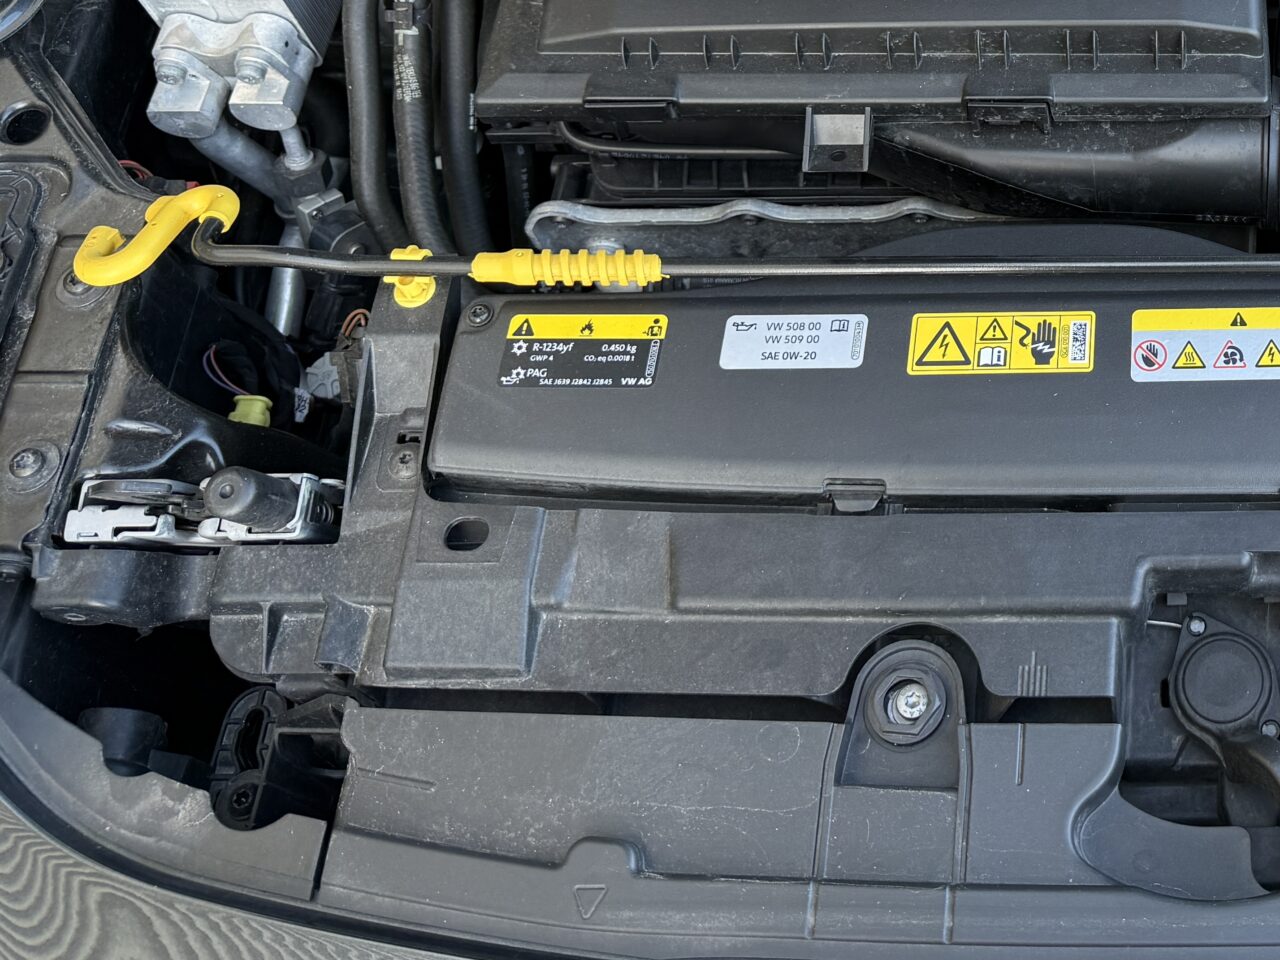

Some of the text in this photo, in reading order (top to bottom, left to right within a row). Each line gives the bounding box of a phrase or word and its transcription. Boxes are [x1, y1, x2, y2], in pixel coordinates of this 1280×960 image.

[766, 322, 822, 331] VW 508 00
[764, 335, 820, 344] VW 509 00
[532, 342, 638, 354] R-1234yf 0.450 kg
[760, 351, 817, 361] SAE 0W-20
[526, 368, 548, 378] PAG
[539, 378, 553, 386] SAE
[553, 378, 571, 386] J639
[621, 378, 637, 386] VW
[637, 378, 653, 386] AG
